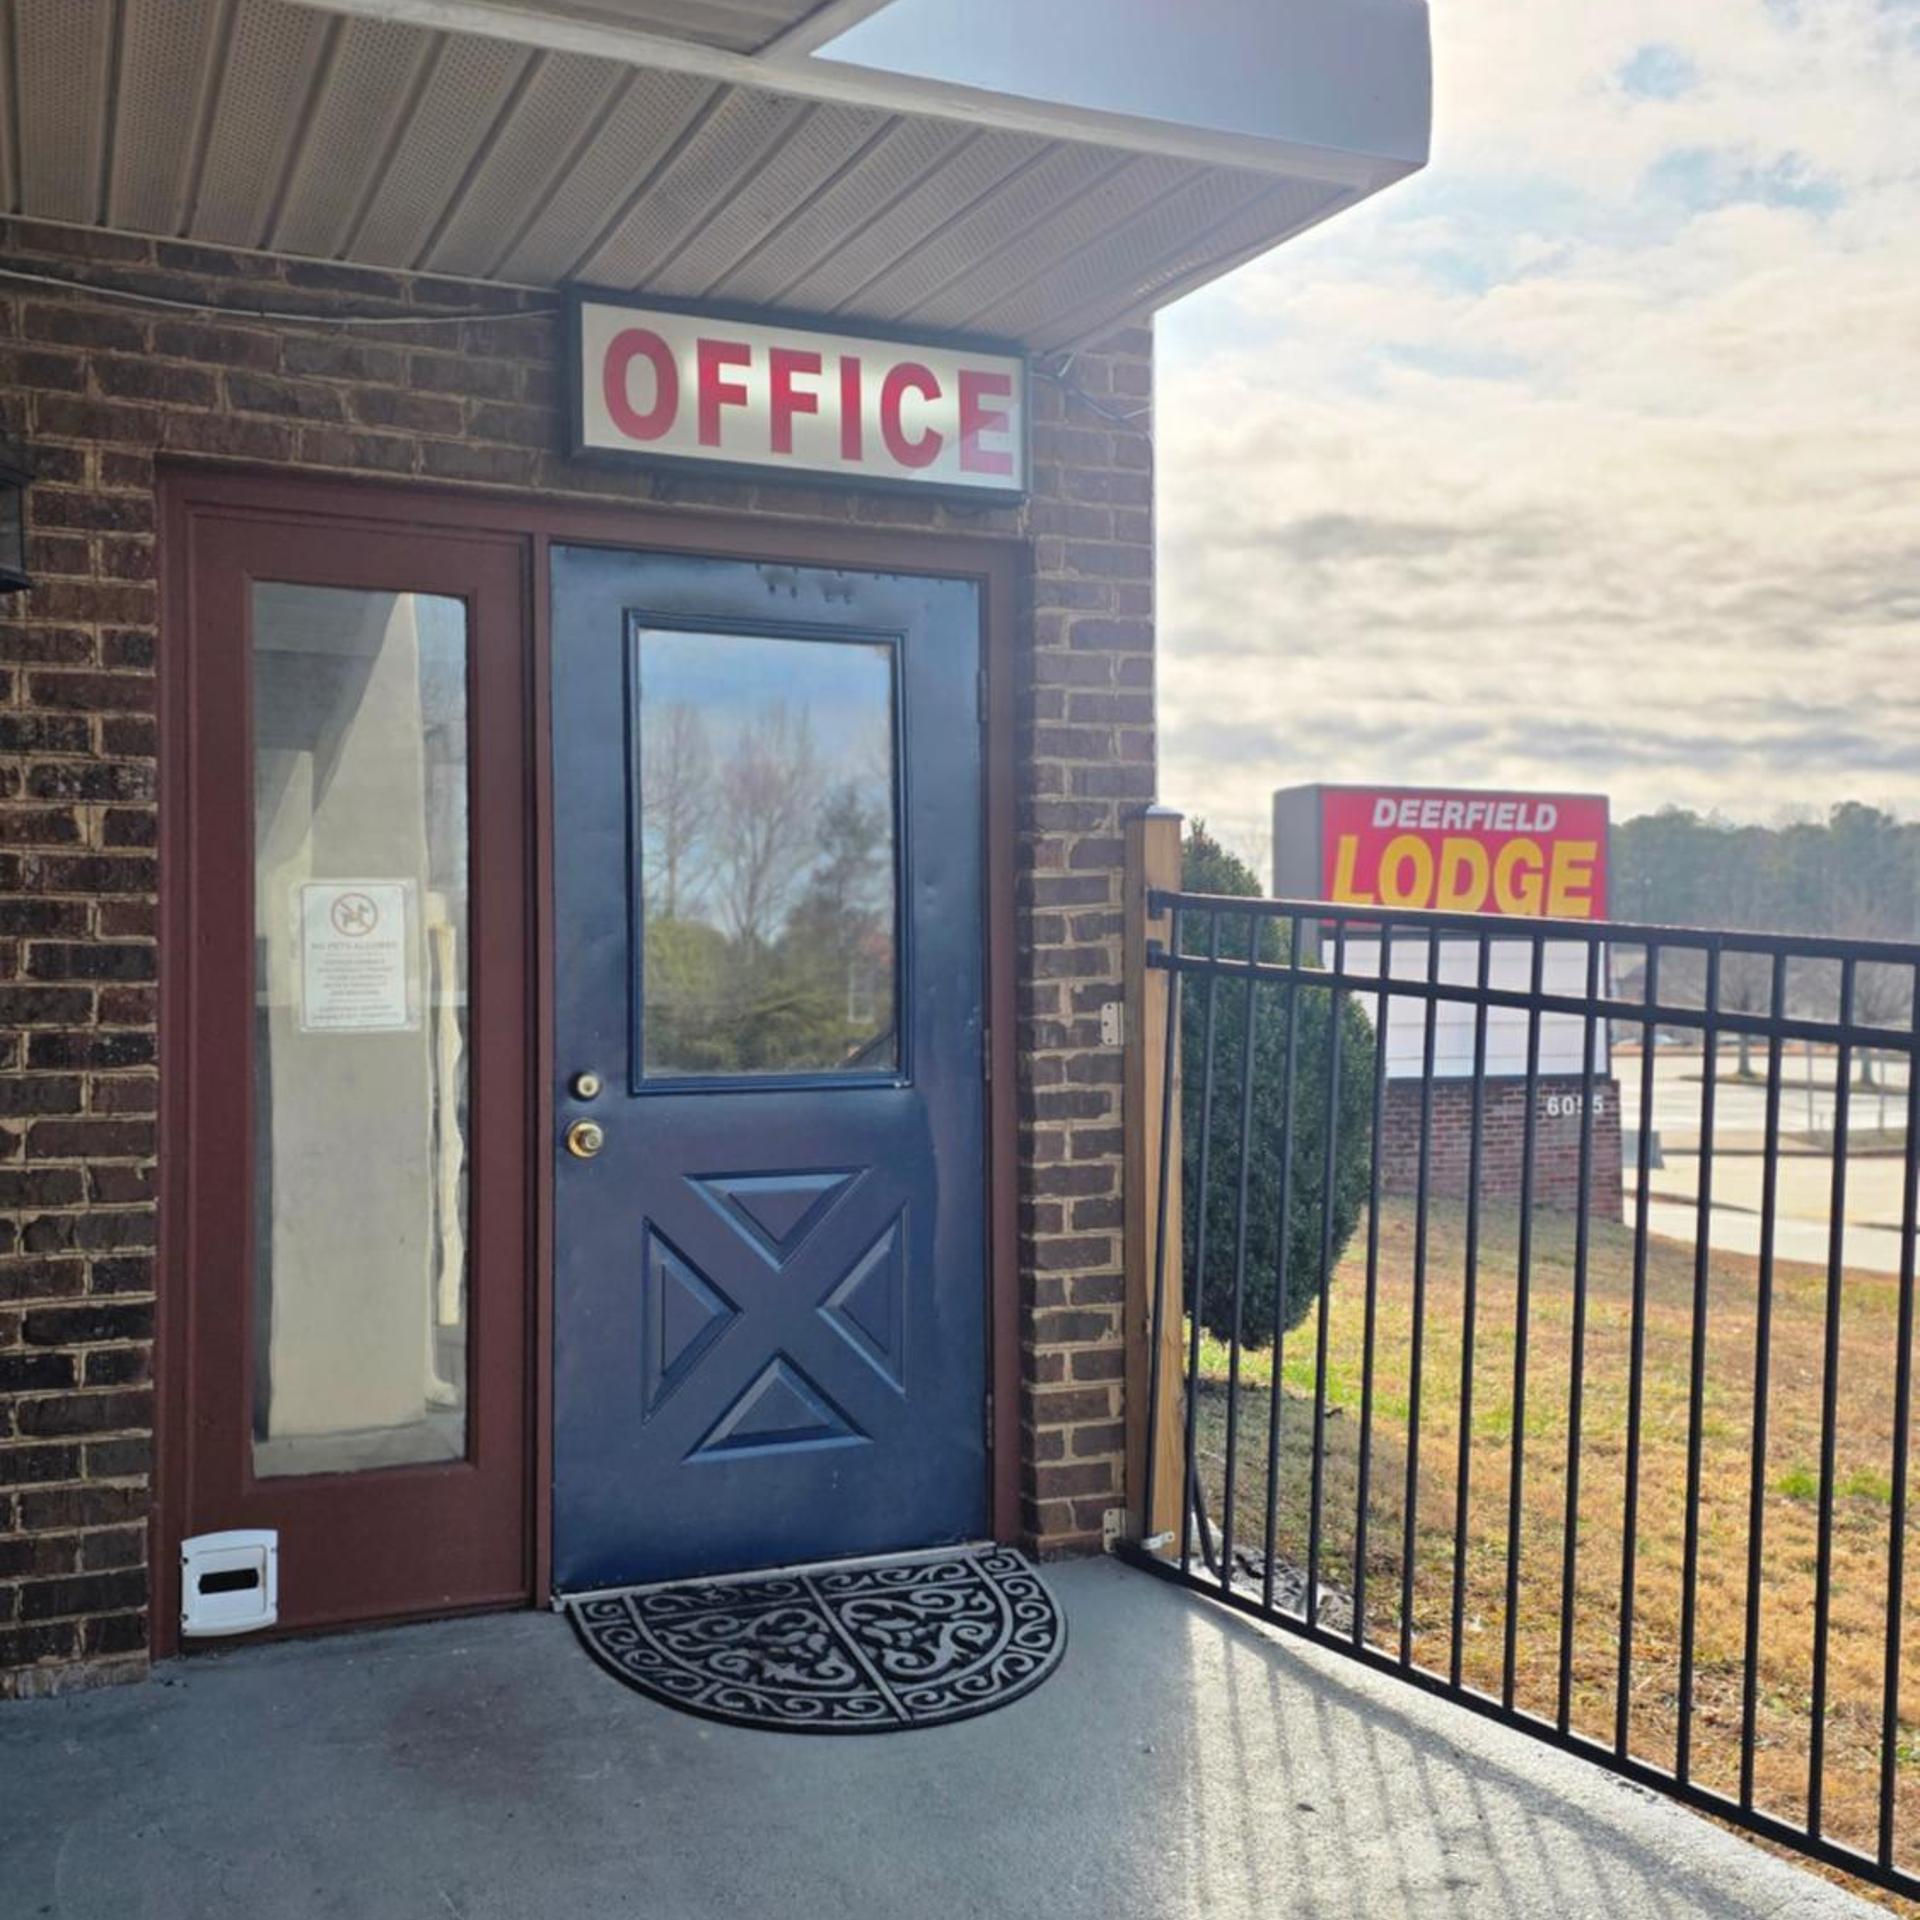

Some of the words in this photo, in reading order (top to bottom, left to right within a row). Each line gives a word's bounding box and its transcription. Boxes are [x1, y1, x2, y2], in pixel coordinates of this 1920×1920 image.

[603, 328, 1013, 475] OFFICE
[1372, 798, 1557, 832] DEERFIELD
[1332, 834, 1597, 918] LODGE
